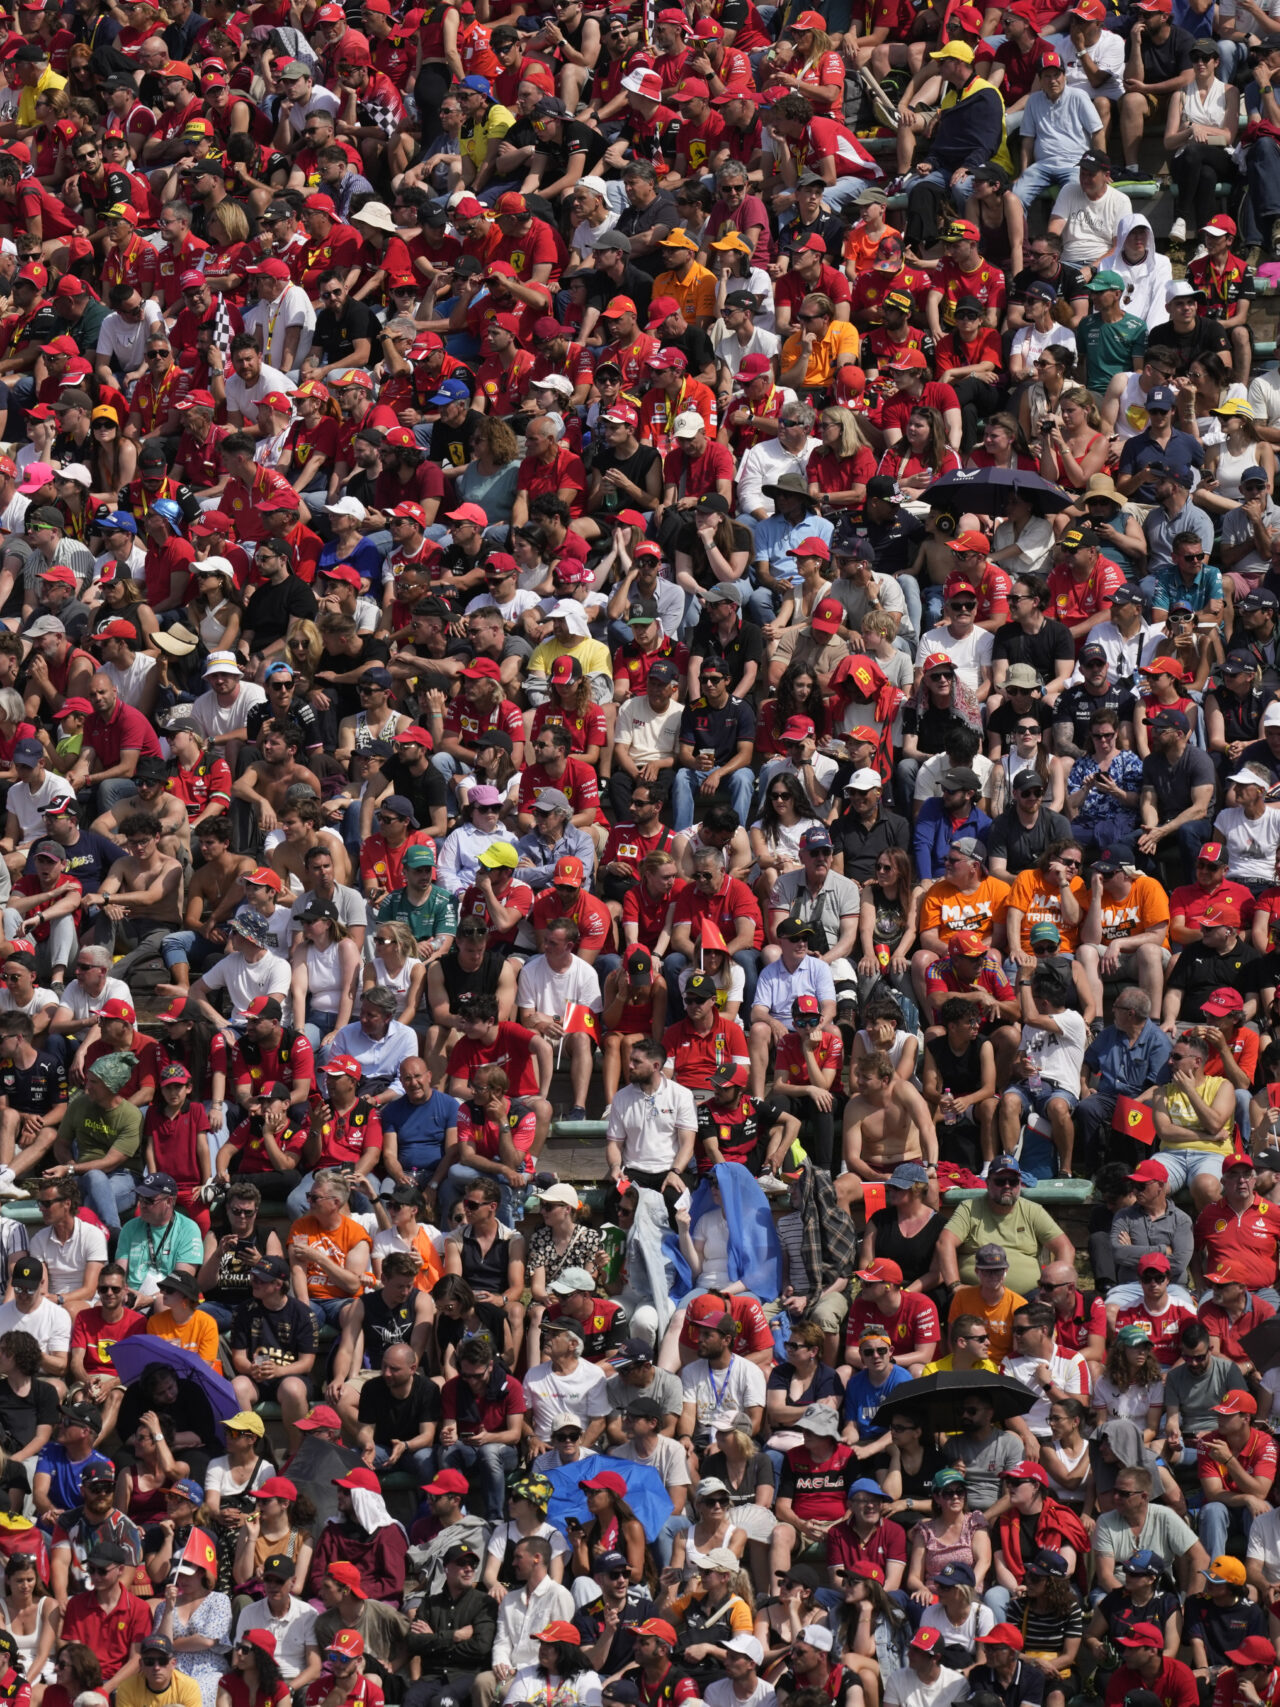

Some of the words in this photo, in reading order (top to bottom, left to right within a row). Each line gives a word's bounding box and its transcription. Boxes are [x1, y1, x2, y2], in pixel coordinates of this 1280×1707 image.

[1031, 893, 1061, 909] MA
[941, 901, 993, 921] MAX
[1027, 912, 1065, 924] TRIBU
